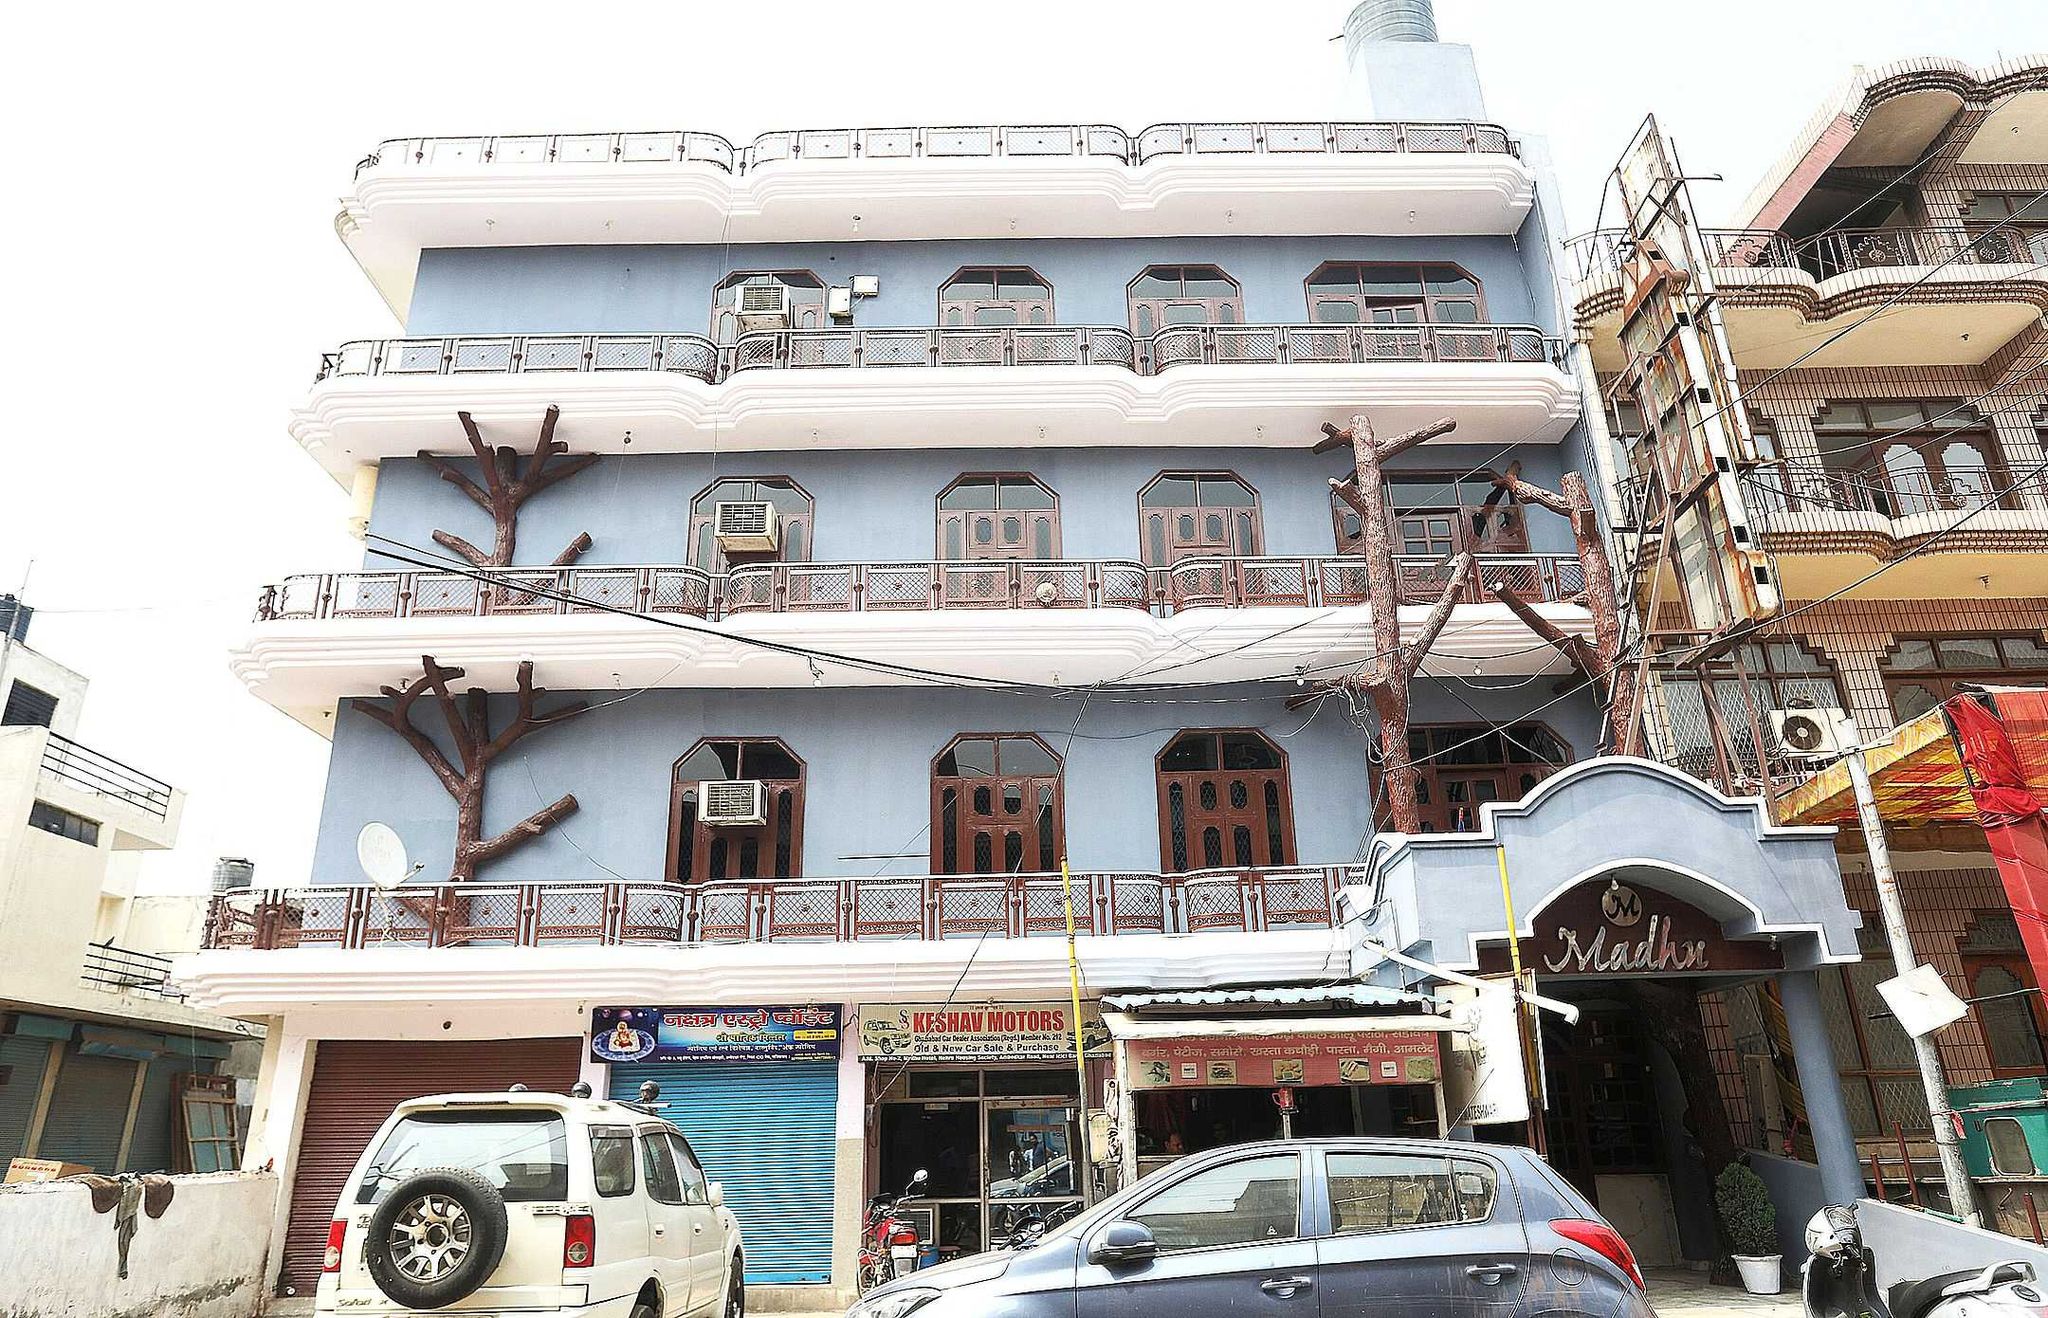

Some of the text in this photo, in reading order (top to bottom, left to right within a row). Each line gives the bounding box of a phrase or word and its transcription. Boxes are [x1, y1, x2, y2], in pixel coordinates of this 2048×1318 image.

[1542, 914, 1709, 973] Madhu
[664, 1013, 717, 1029] नक्षत्र
[721, 1008, 769, 1031] एस्ट्रो
[913, 1010, 1065, 1033] KESHAV MOTORS
[952, 1034, 969, 1042] Dealer
[970, 1033, 1000, 1041] Association
[914, 1042, 1060, 1053] Old & New Car Sale & Purchase
[1250, 1047, 1281, 1057] खस्ता
[1394, 1042, 1434, 1054] आमलेट
